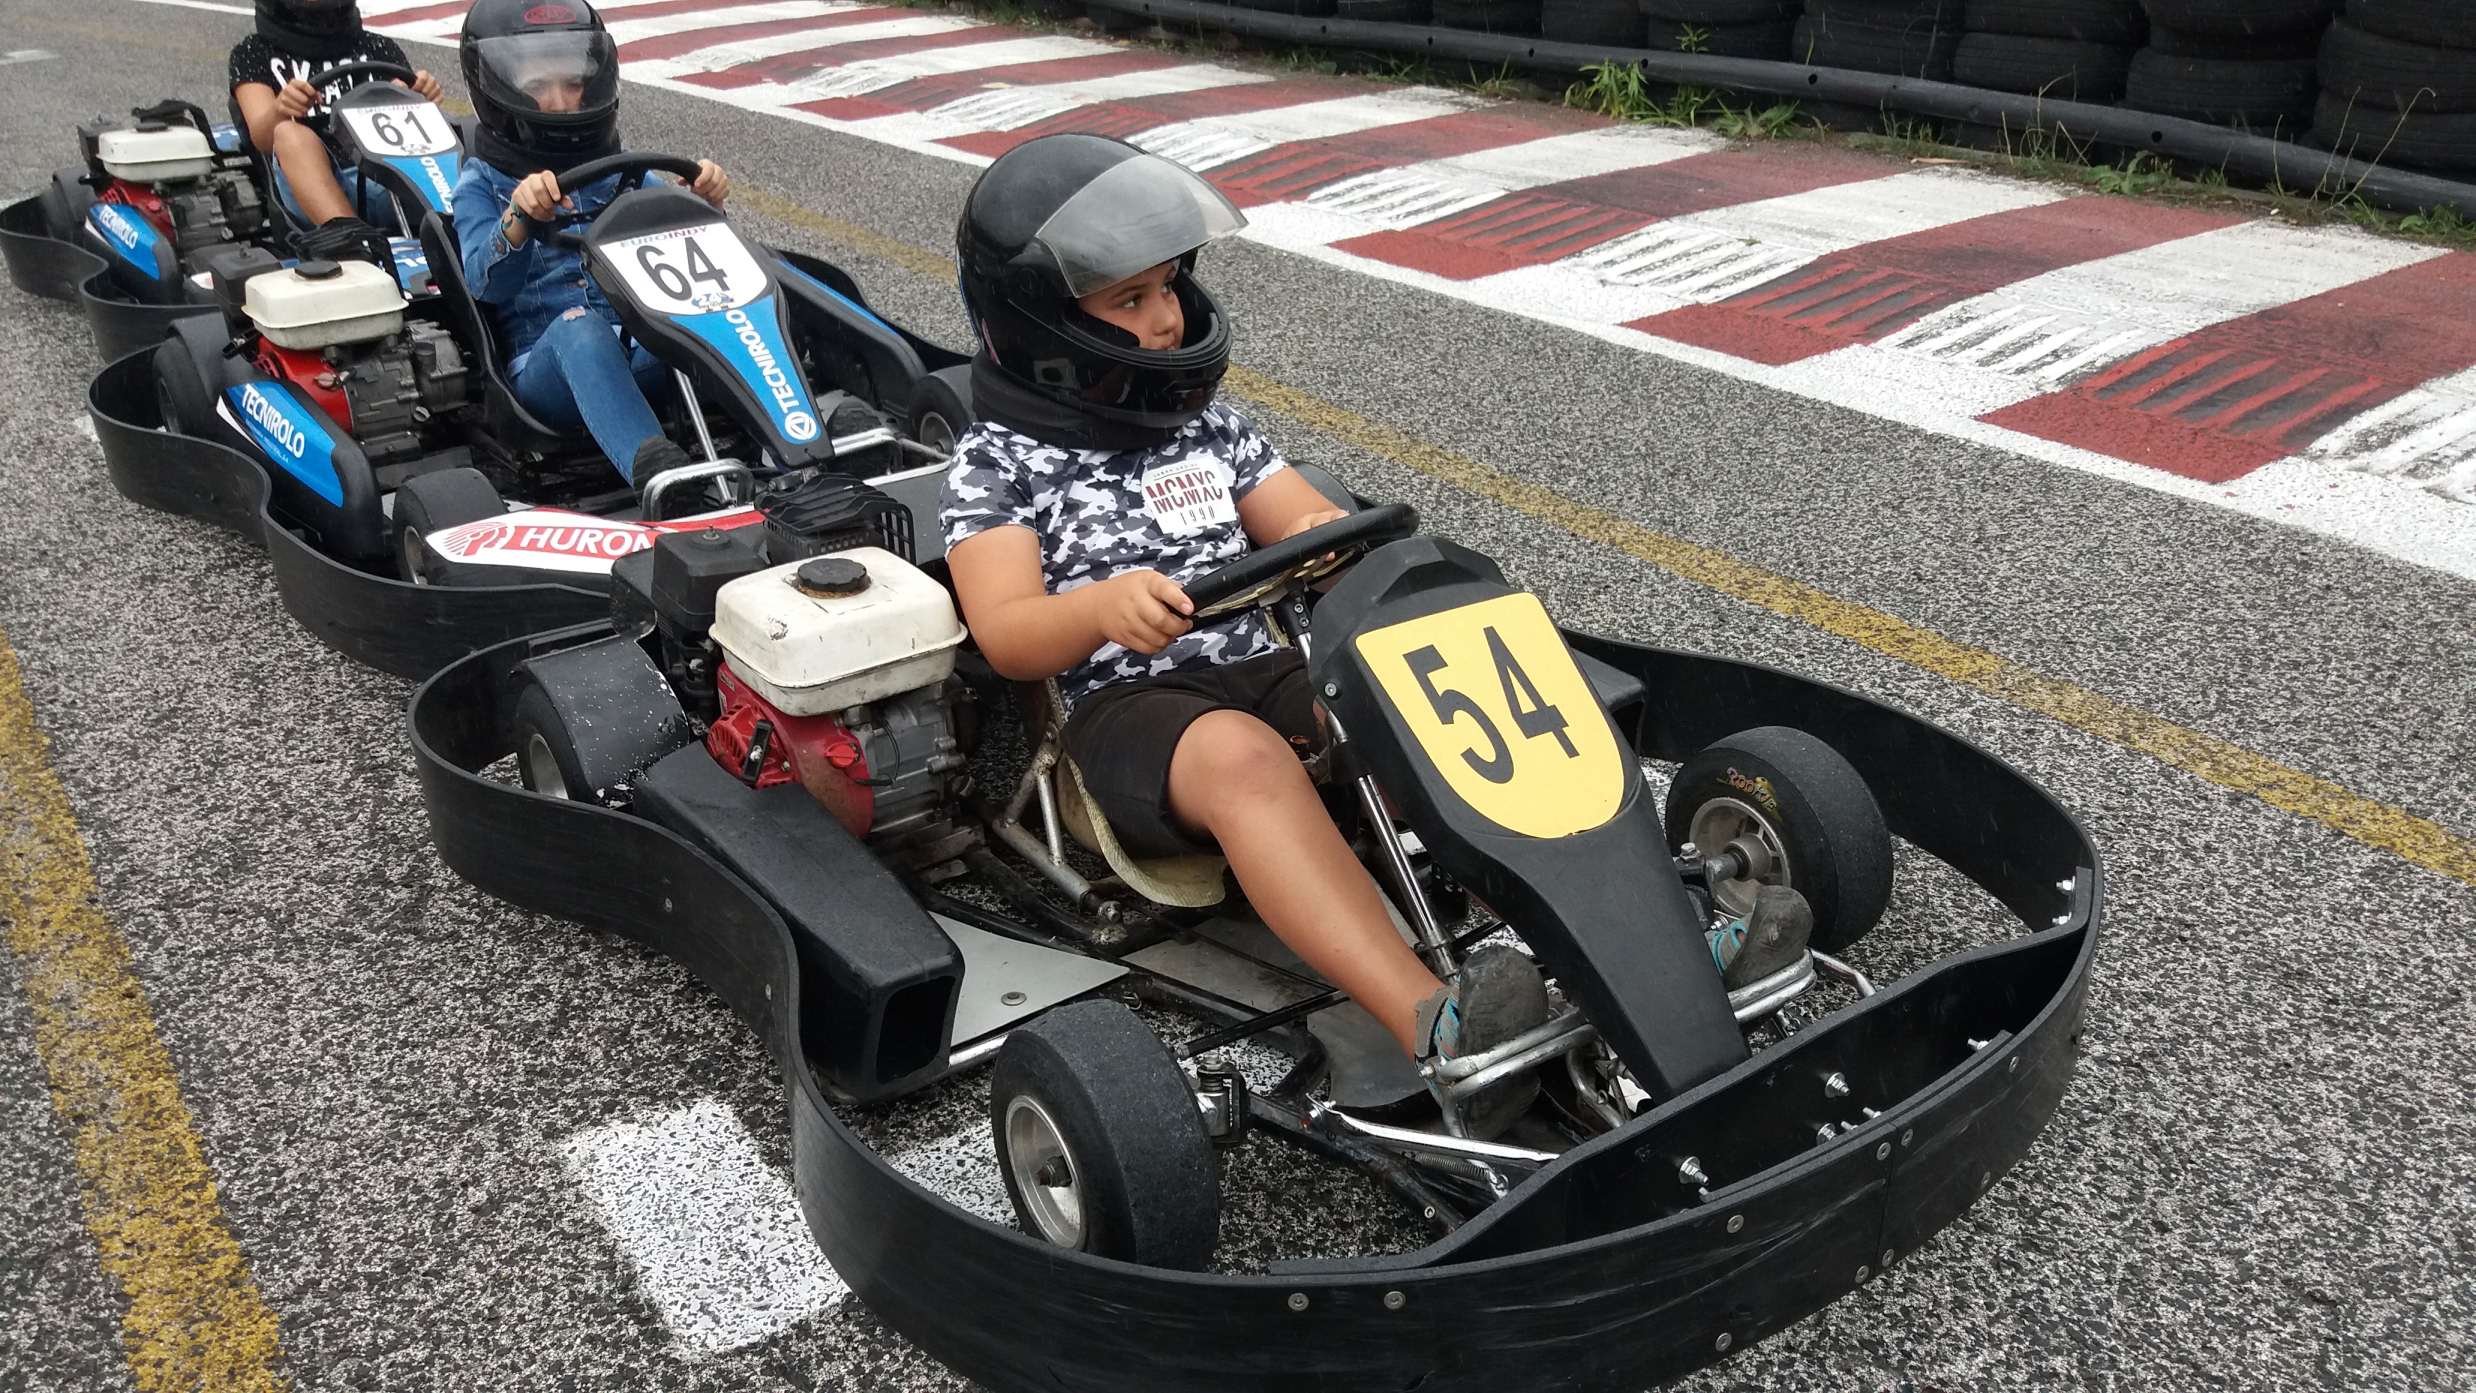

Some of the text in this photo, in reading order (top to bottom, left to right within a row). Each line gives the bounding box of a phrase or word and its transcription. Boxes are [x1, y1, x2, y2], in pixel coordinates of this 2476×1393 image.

[372, 111, 432, 146] 61
[636, 236, 730, 301] 64
[725, 309, 800, 414] TECNIROLO
[242, 383, 305, 458] TECNIROLO
[1402, 625, 1580, 785] 54
